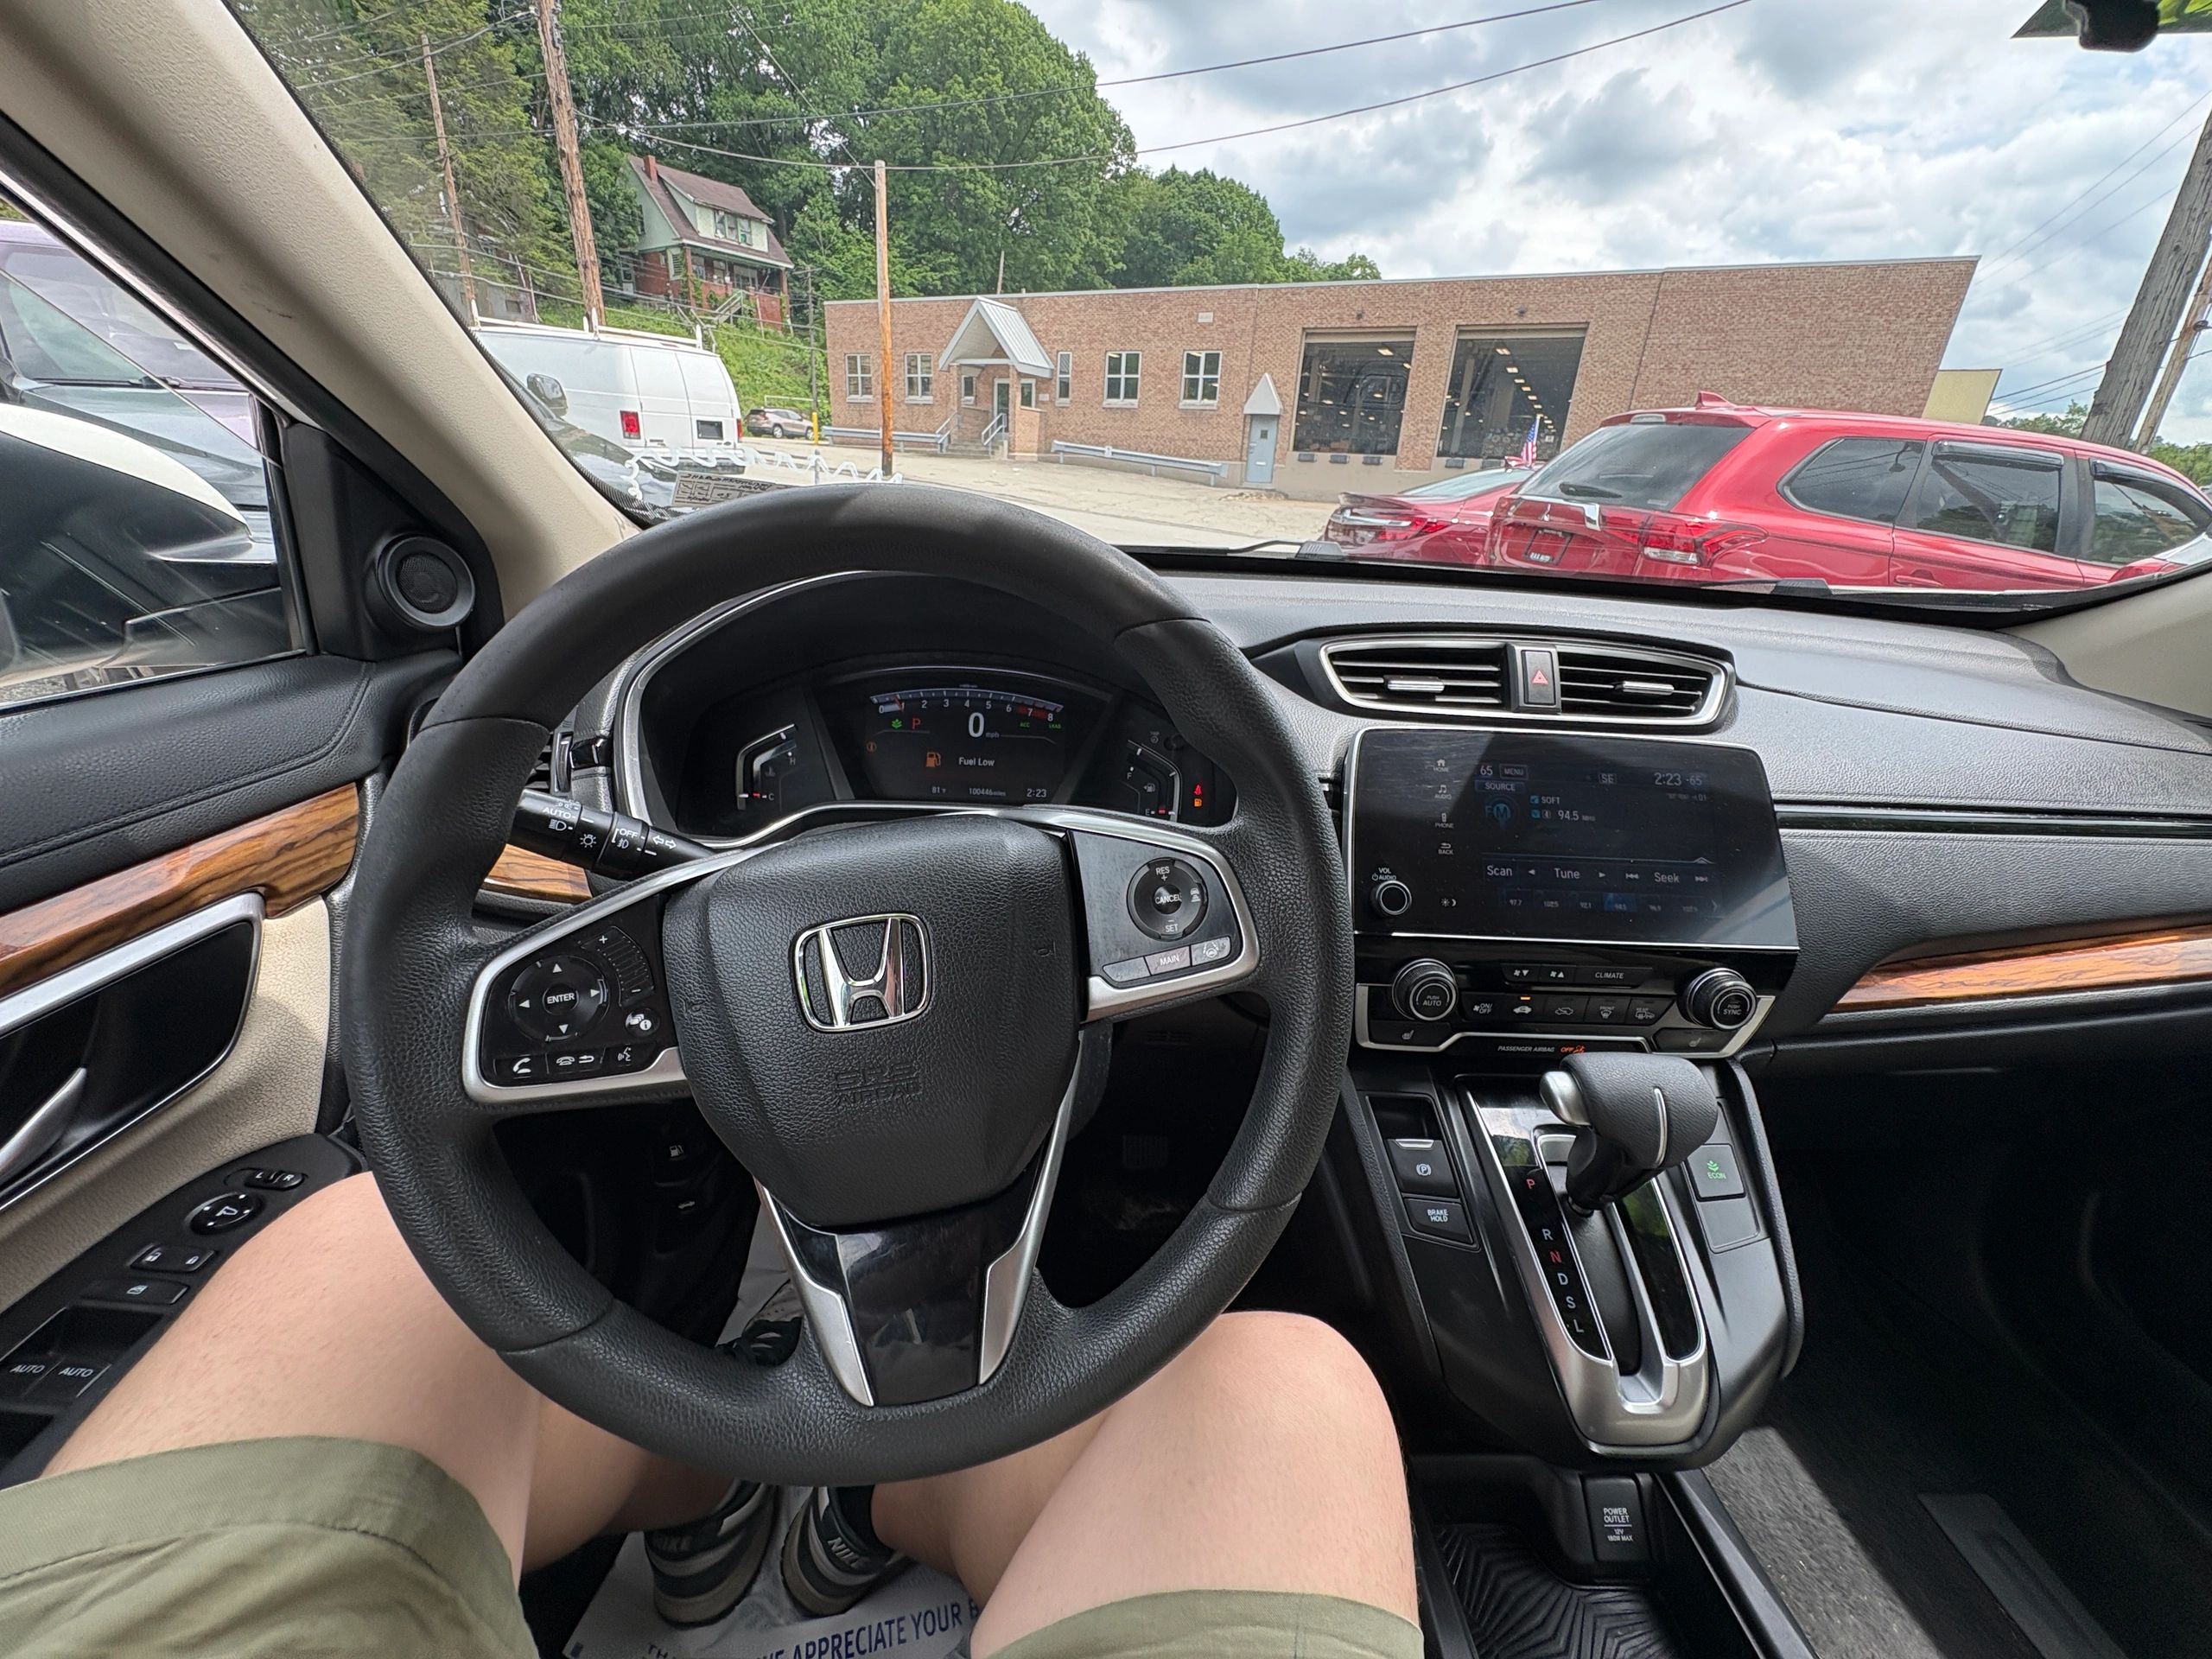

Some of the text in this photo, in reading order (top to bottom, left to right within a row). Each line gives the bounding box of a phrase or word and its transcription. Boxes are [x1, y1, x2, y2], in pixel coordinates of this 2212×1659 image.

[921, 700, 927, 709] 2
[943, 699, 950, 708] 3
[985, 701, 992, 709] 5
[1006, 704, 1012, 713] 6
[1027, 708, 1033, 717] 7
[1047, 712, 1053, 721] 8
[912, 718, 921, 729] P
[968, 712, 985, 738] 0
[958, 757, 995, 766] Fuel Low
[1654, 772, 1681, 786] 2:23
[969, 787, 993, 796] 100446
[1484, 782, 1516, 791] SOURCE
[1027, 788, 1047, 798] 2:23
[543, 806, 572, 820] AUTO
[1557, 810, 1580, 821] 94.5
[619, 827, 639, 839] OFF
[1155, 866, 1170, 875] RES
[1486, 865, 1513, 877] Scan
[1554, 867, 1580, 880] Tune
[1654, 872, 1680, 883] Seek
[1155, 894, 1180, 905] CANCEL
[1166, 924, 1179, 933] SET
[1160, 956, 1179, 966] MAIN
[1594, 971, 1624, 980] CLIMATE
[546, 993, 575, 1005] ENTER
[1527, 1179, 1535, 1189] P
[1543, 1229, 1554, 1241] R
[1550, 1251, 1560, 1263] N
[1559, 1274, 1568, 1286] D
[1566, 1296, 1576, 1308] S
[1573, 1321, 1584, 1333] L
[10, 1365, 45, 1374] AUTO
[59, 1367, 93, 1377] AUTO
[792, 1617, 907, 1659] APPRECIATE
[910, 1602, 963, 1640] YOUR
